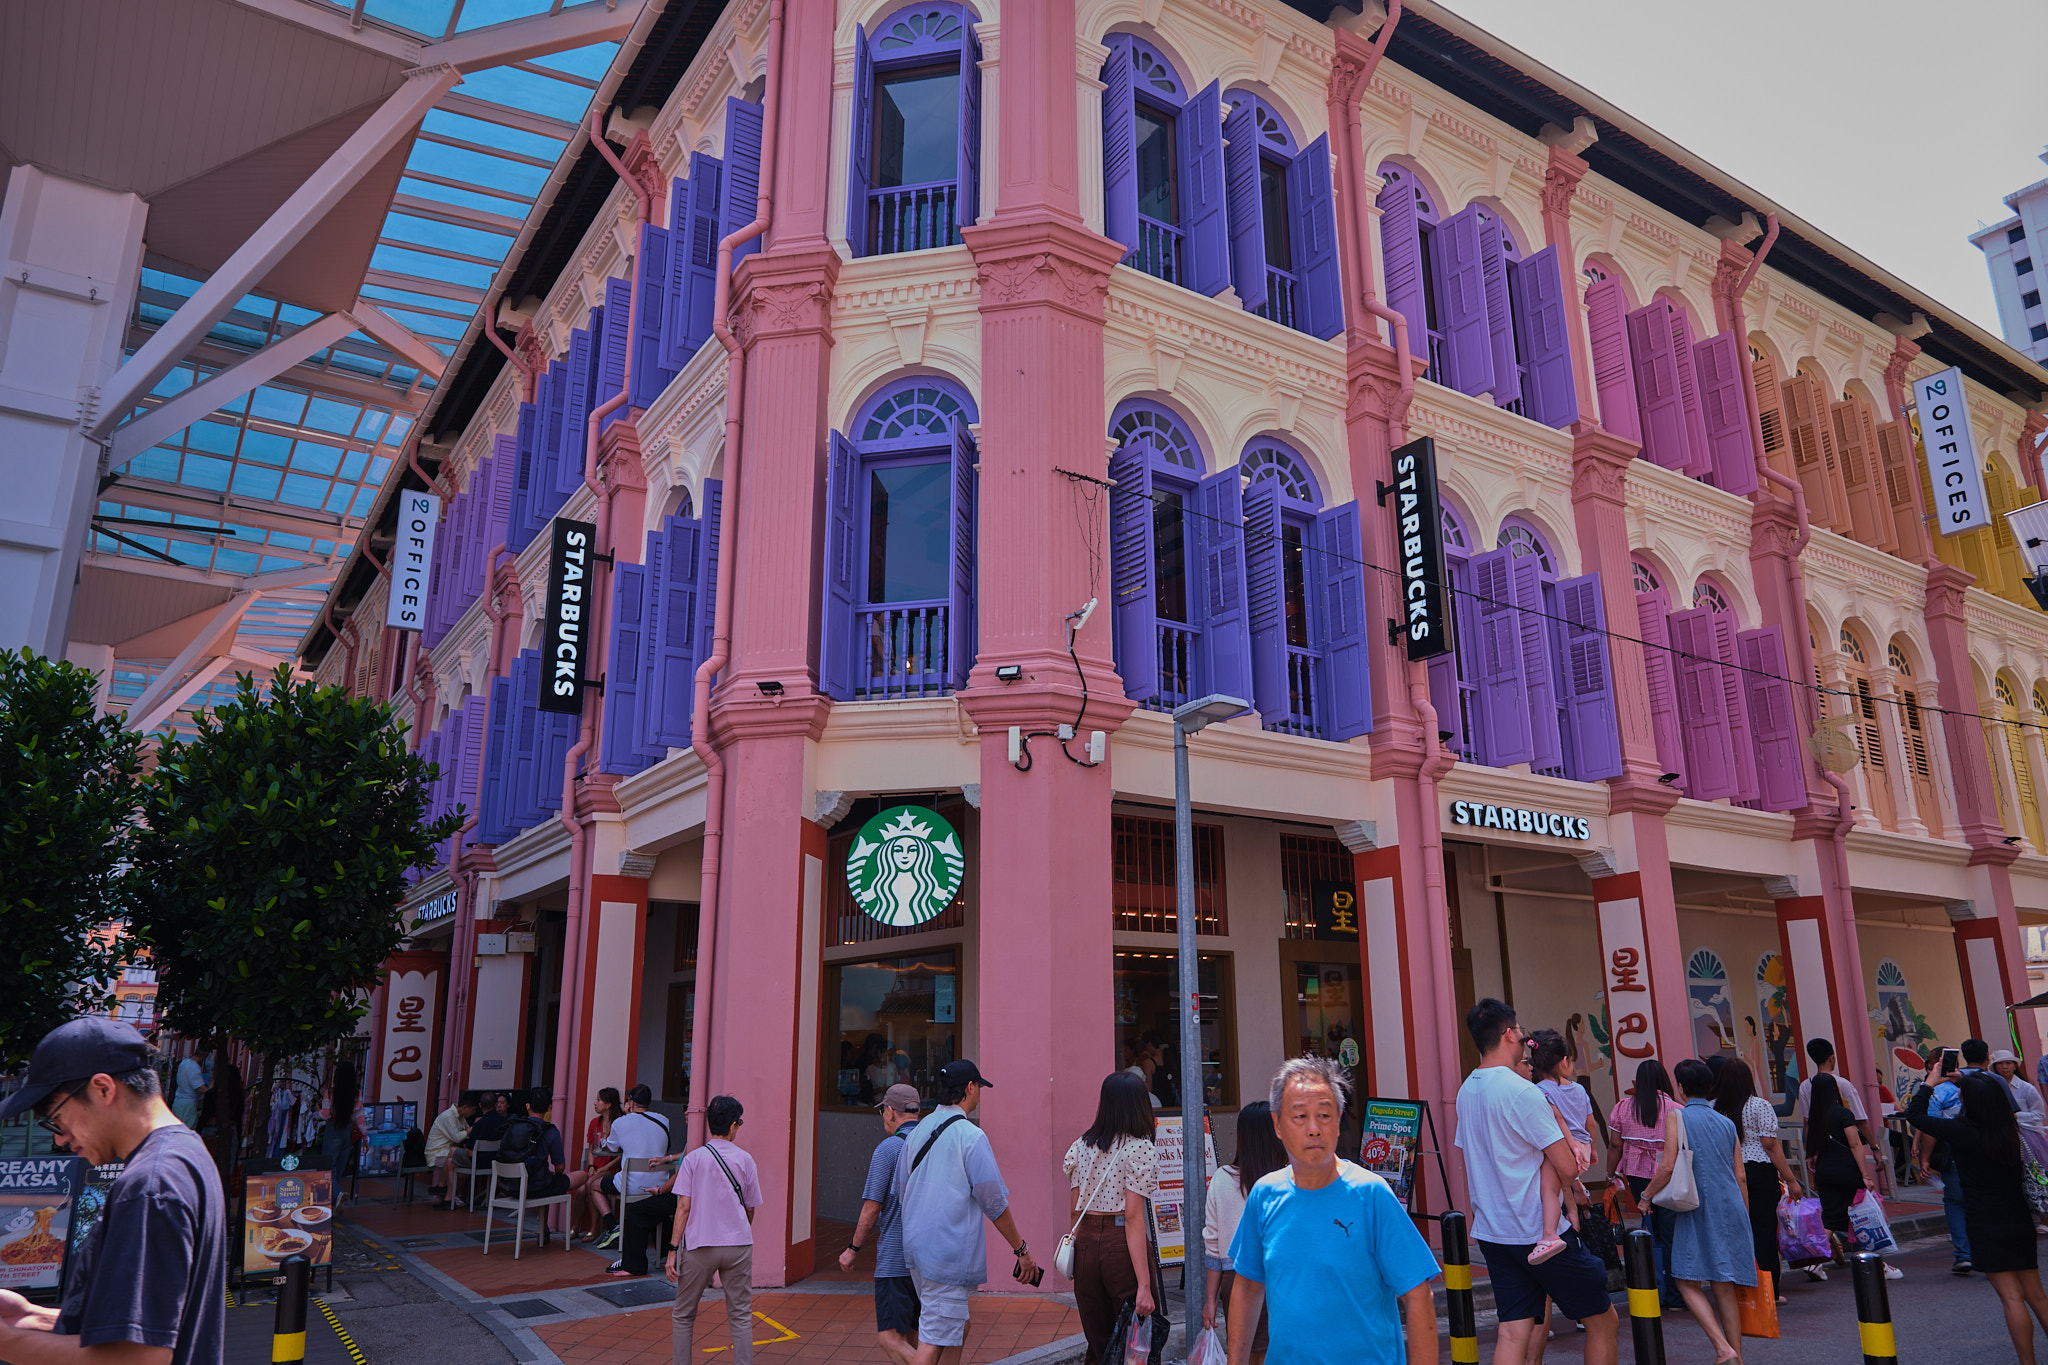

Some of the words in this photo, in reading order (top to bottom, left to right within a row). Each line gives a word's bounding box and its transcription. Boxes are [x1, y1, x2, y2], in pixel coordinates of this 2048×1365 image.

[1932, 404, 1971, 524] OFFICES
[1397, 455, 1429, 641] STARBUCKS
[401, 519, 426, 623] OFFICES
[553, 530, 587, 698] STARBUCKS
[1453, 800, 1591, 841] STARBUCKS
[417, 891, 457, 921] STARBUCKS
[1330, 890, 1359, 934] 星
[1610, 947, 1656, 1096] 星巴
[387, 995, 426, 1101] 星巴
[1369, 1120, 1392, 1131] Prime
[1392, 1122, 1412, 1134] Spot
[1372, 1106, 1394, 1117] Pagoda
[1394, 1108, 1414, 1117] Street
[1366, 1145, 1386, 1160] 40%
[0, 1172, 58, 1188] AKSA
[279, 1184, 300, 1192] Smith
[8, 1264, 55, 1273] CHINATOWN
[12, 1271, 41, 1279] STREET
